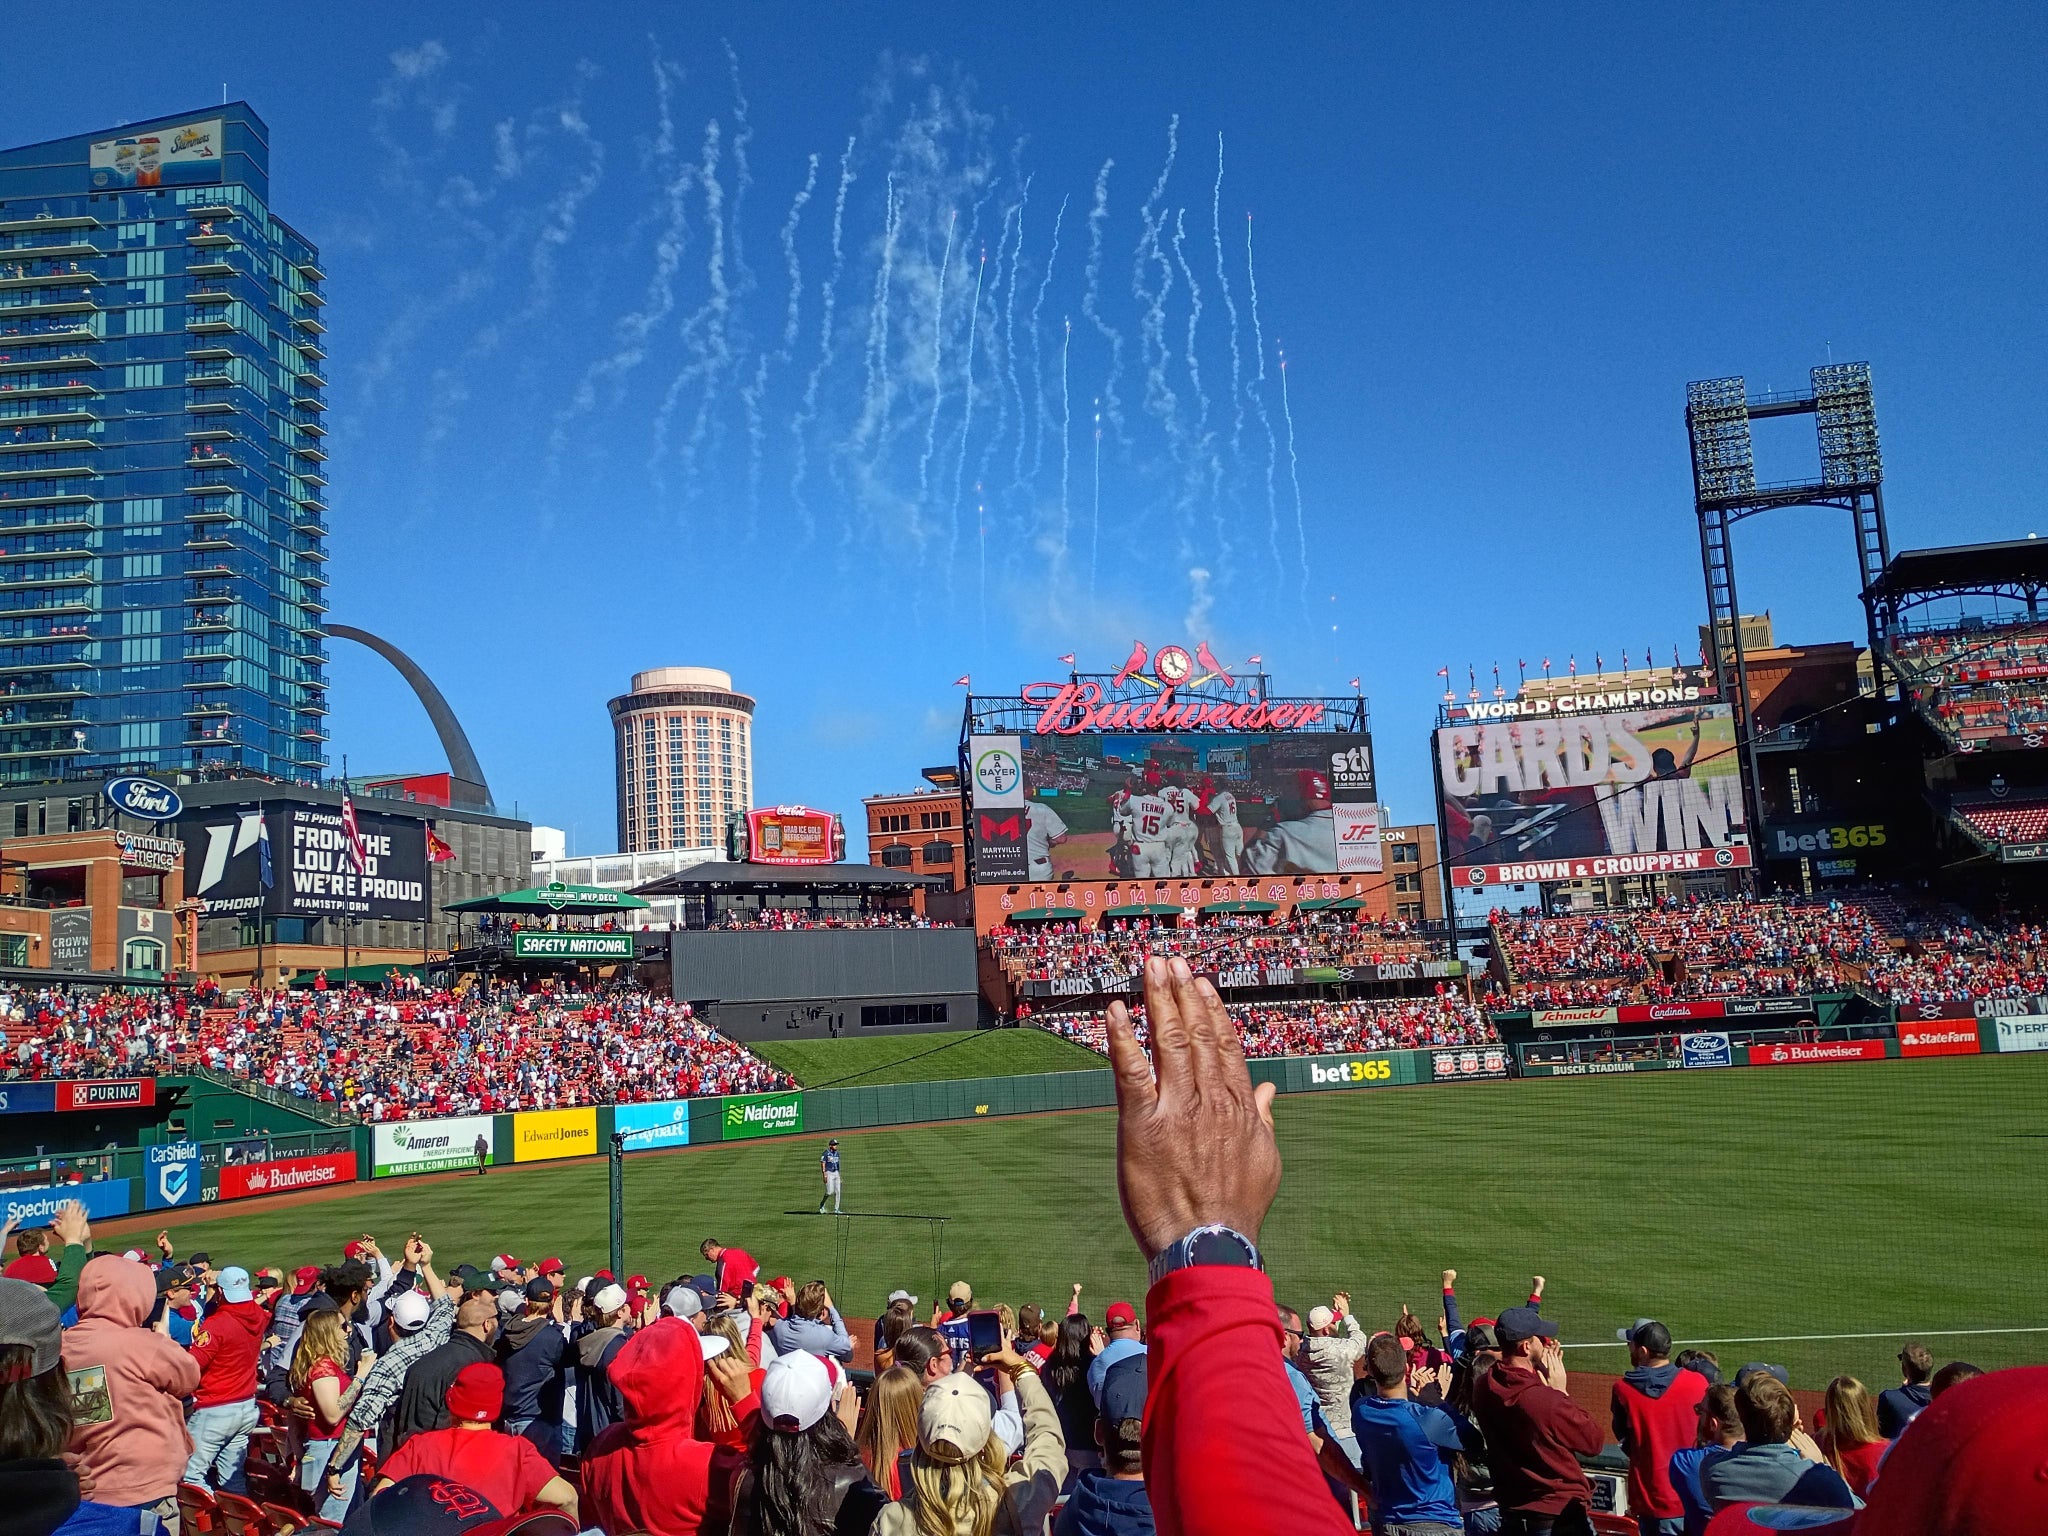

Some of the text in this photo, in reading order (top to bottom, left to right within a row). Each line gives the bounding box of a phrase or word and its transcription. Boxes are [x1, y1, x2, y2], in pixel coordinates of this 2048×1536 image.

[1989, 670, 2004, 678] THIS
[1022, 682, 1324, 734] Budweiser
[1465, 686, 1700, 719] WORLD CHAMPIONS
[1331, 746, 1370, 772] stl
[1438, 711, 1652, 797] CARDS
[980, 768, 1016, 776] BAYER
[1333, 773, 1371, 781] TODAY
[125, 782, 170, 813] Ford
[776, 804, 806, 816] Coca-Cola
[1594, 775, 1750, 855] WIN!
[294, 811, 343, 826] 1ST PHOR
[1142, 815, 1161, 836] 15
[783, 833, 821, 842] REFRESHMENT
[798, 826, 807, 834] ICE
[116, 831, 182, 857] Community
[293, 826, 391, 856] FROM THE
[1777, 825, 1886, 852] bet365
[293, 848, 332, 871] LOU
[2013, 849, 2036, 858] Mercy
[1499, 852, 1699, 881] BROWN & CROUPPEN
[1817, 859, 1857, 870] bet365
[980, 870, 1026, 878] maryville.edu
[293, 871, 422, 902] WE'RE PROUD
[580, 892, 618, 902] MVP DECK
[1029, 892, 1036, 908] 1
[1045, 892, 1056, 908] 2
[1064, 891, 1075, 908] 6
[1084, 890, 1096, 907] 9
[1104, 889, 1121, 906] 10
[1129, 889, 1146, 905] 14
[1155, 887, 1171, 904] 17
[1180, 888, 1200, 904] 20
[1211, 886, 1231, 903] 23
[1239, 886, 1259, 901] 24
[1268, 884, 1287, 900] 42
[1296, 883, 1316, 900] 45
[1321, 883, 1340, 899] 85
[199, 896, 265, 912] TPHORM
[52, 936, 89, 948] CROWN
[522, 938, 627, 953] SAFETY NATIONAL
[58, 947, 84, 959] HALL
[1218, 968, 1294, 988] CARDS WIN!
[1377, 961, 1448, 980] CARDS WIN!
[1051, 976, 1130, 995] CARDS WIN!
[1540, 1009, 1608, 1021] Schnucks
[1650, 1005, 1692, 1020] Cardinals
[1734, 1004, 1757, 1013] Mercy
[1974, 998, 2029, 1018] CARDS
[2015, 1023, 2048, 1034] PERF
[1691, 1037, 1718, 1049] Ford
[1791, 1046, 1863, 1059] Budweiser
[1311, 1060, 1391, 1084] bet365
[1439, 1060, 1499, 1071] 66 66 66
[1552, 1063, 1635, 1075] BUSCH STADIUM
[90, 1085, 137, 1100] PURINA
[763, 1119, 796, 1129] Car Rental
[406, 1135, 449, 1151] Ameren
[151, 1144, 197, 1163] CarShield
[200, 1154, 216, 1162] ATT
[275, 1147, 348, 1158] HYATT EGECY
[423, 1146, 476, 1157] ENERGY EFFICIENC
[389, 1159, 479, 1175] AMEREN.COM/REBATE
[270, 1165, 336, 1188] Budweiser
[202, 1187, 218, 1202] 375'
[8, 1198, 73, 1220] Spectrum
